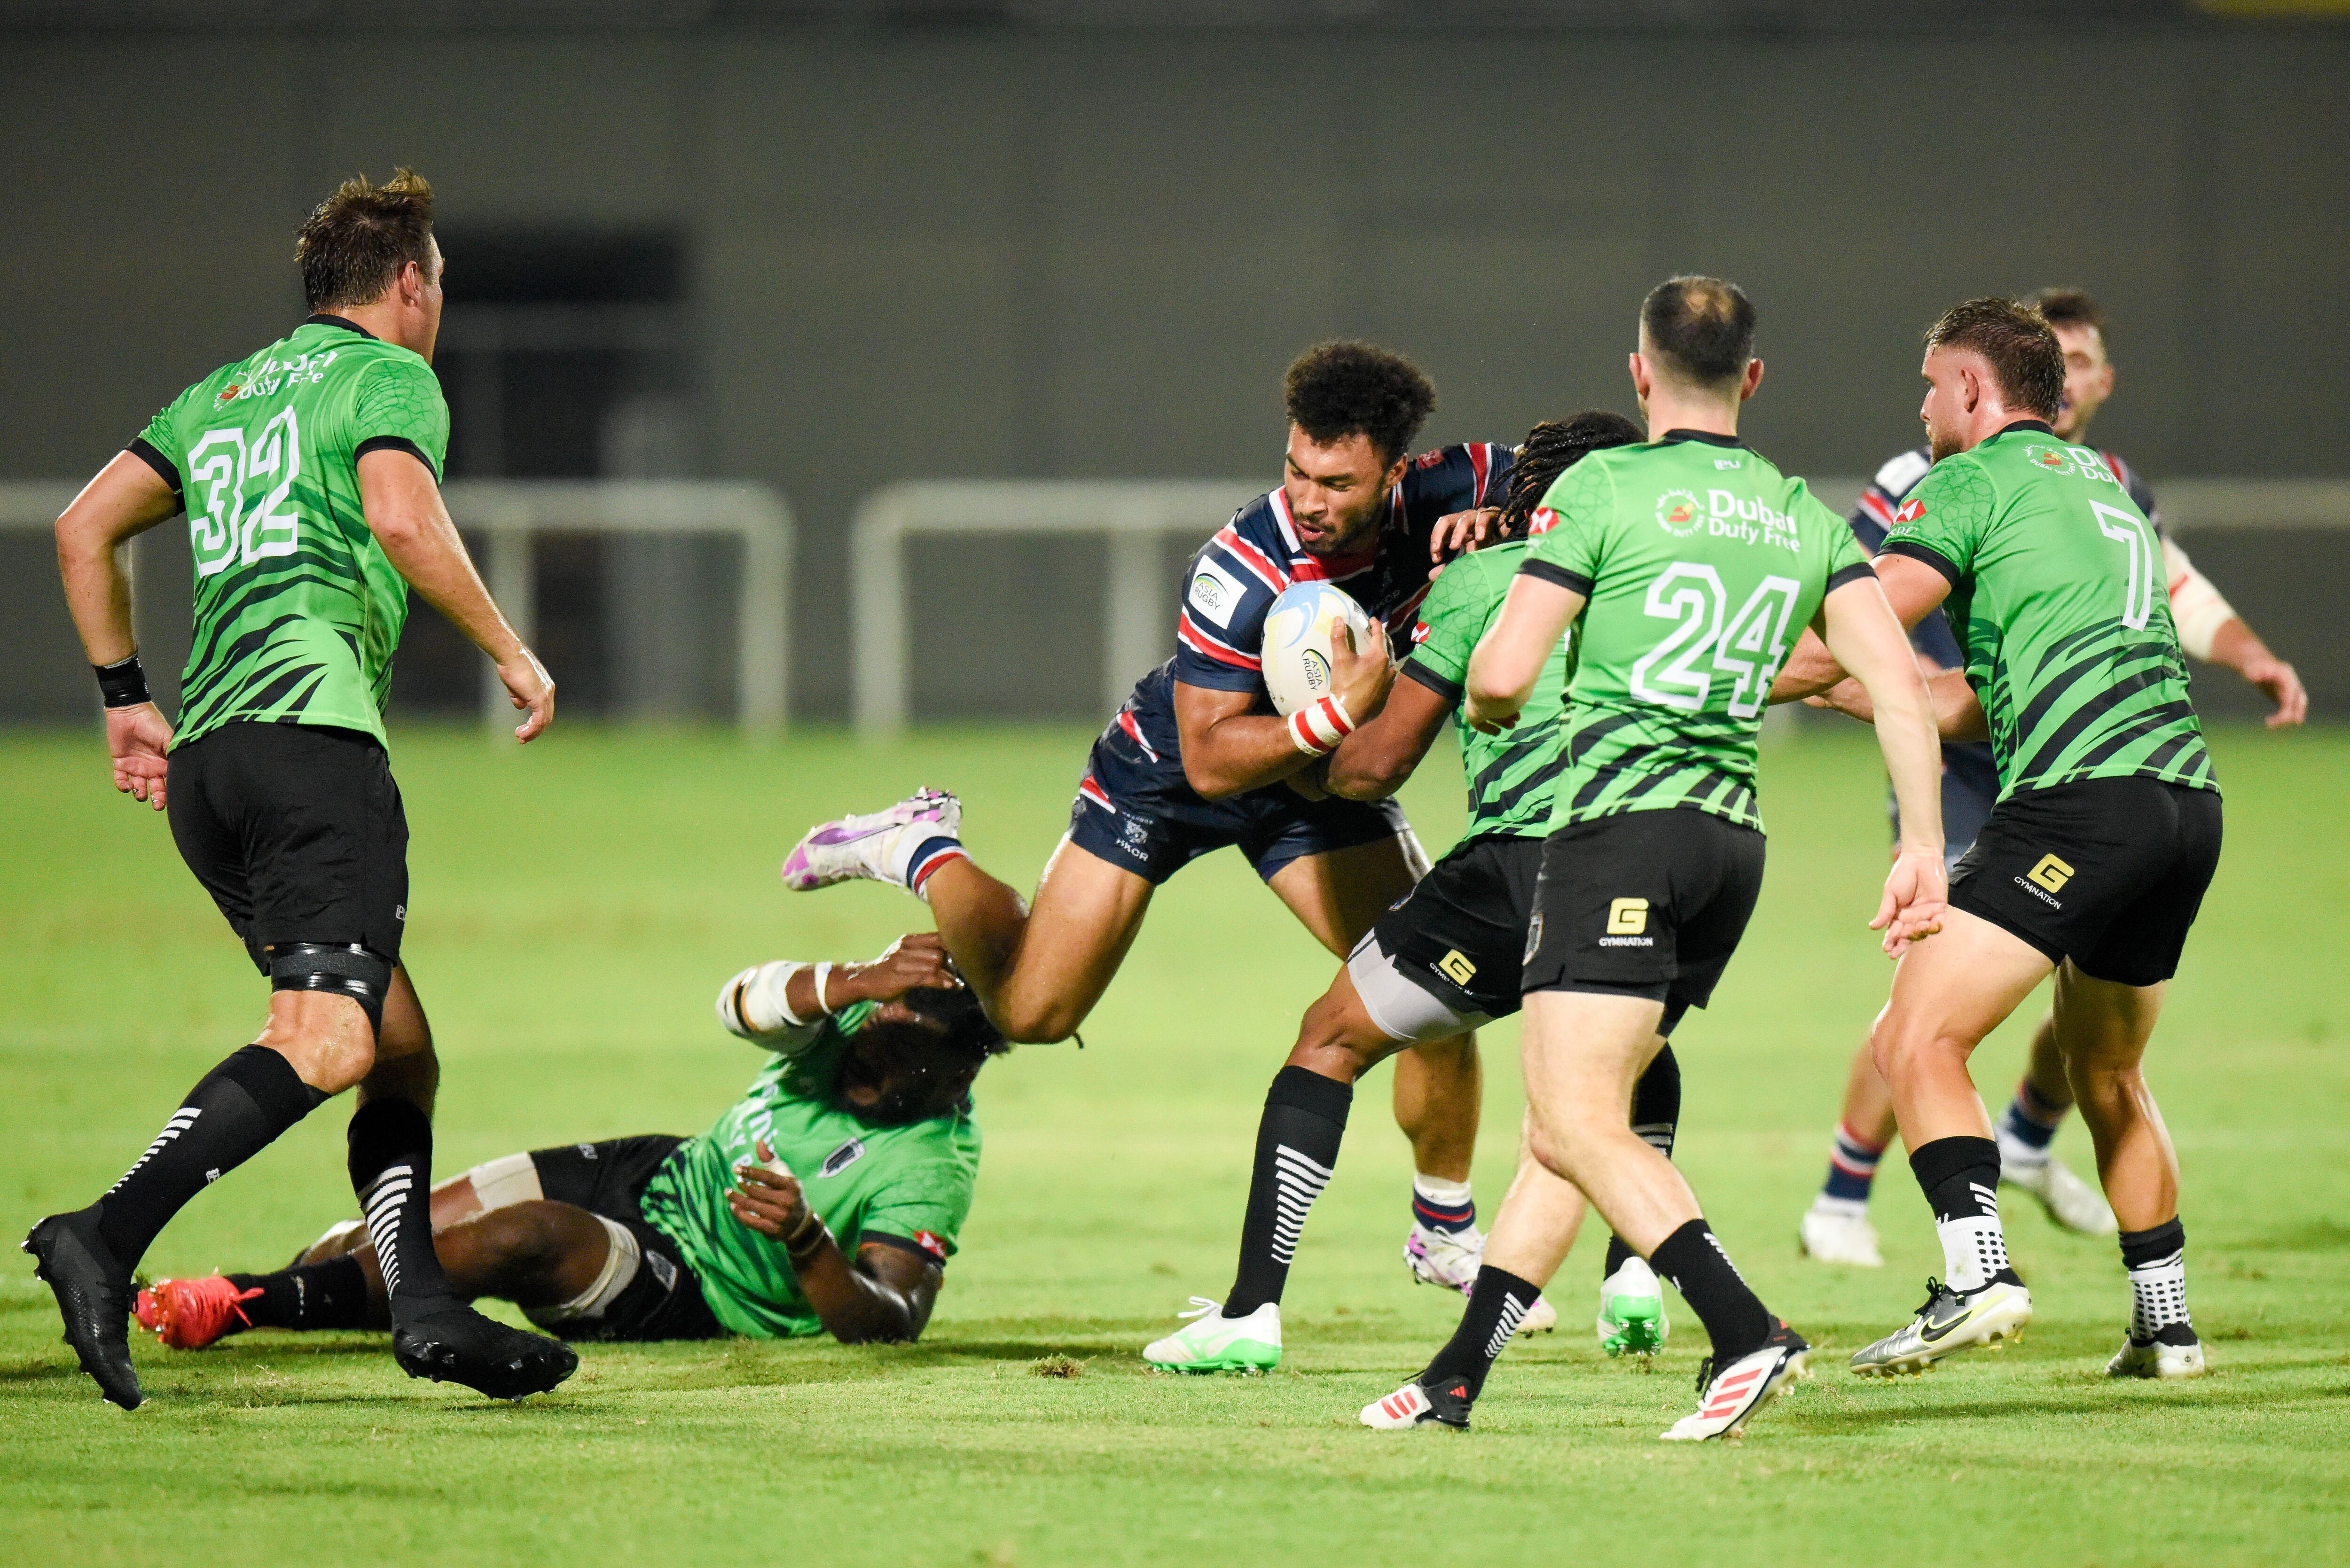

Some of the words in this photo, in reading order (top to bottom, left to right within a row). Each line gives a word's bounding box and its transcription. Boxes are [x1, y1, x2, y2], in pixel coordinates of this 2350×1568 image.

[188, 405, 300, 579] 32
[1708, 517, 1759, 546] Duty
[2088, 498, 2153, 632] 7
[1195, 586, 1221, 610] RUGBY
[1198, 582, 1218, 601] ASIA
[1629, 561, 1801, 719] 24
[1302, 658, 1318, 691] RUGBY
[1311, 660, 1323, 686] ASIA
[2013, 876, 2062, 910] GYMNATION
[1598, 936, 1654, 947] GYMNATION
